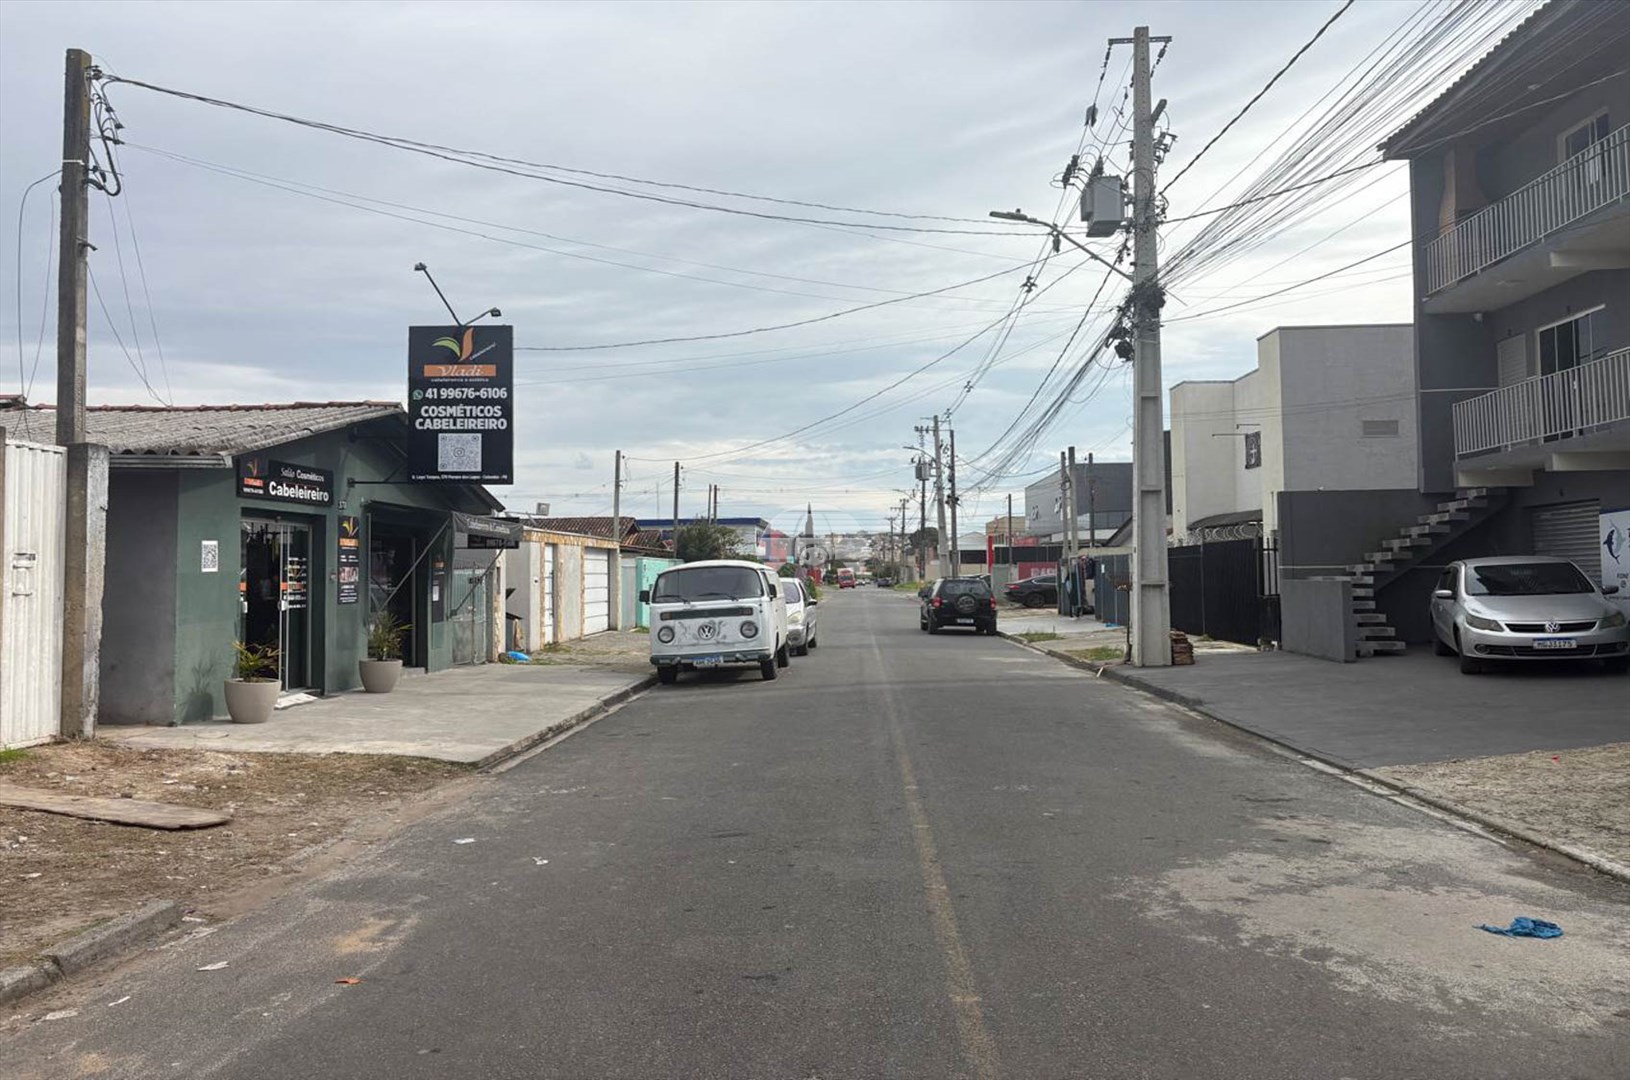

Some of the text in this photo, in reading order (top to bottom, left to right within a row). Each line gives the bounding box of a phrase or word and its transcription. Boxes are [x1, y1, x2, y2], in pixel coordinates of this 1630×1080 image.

[425, 387, 507, 399] 41 99676-6106
[421, 404, 502, 417] COSMÉTICOS
[415, 418, 508, 430] CABELEIREIRO
[269, 481, 329, 502] Cabeleireiro
